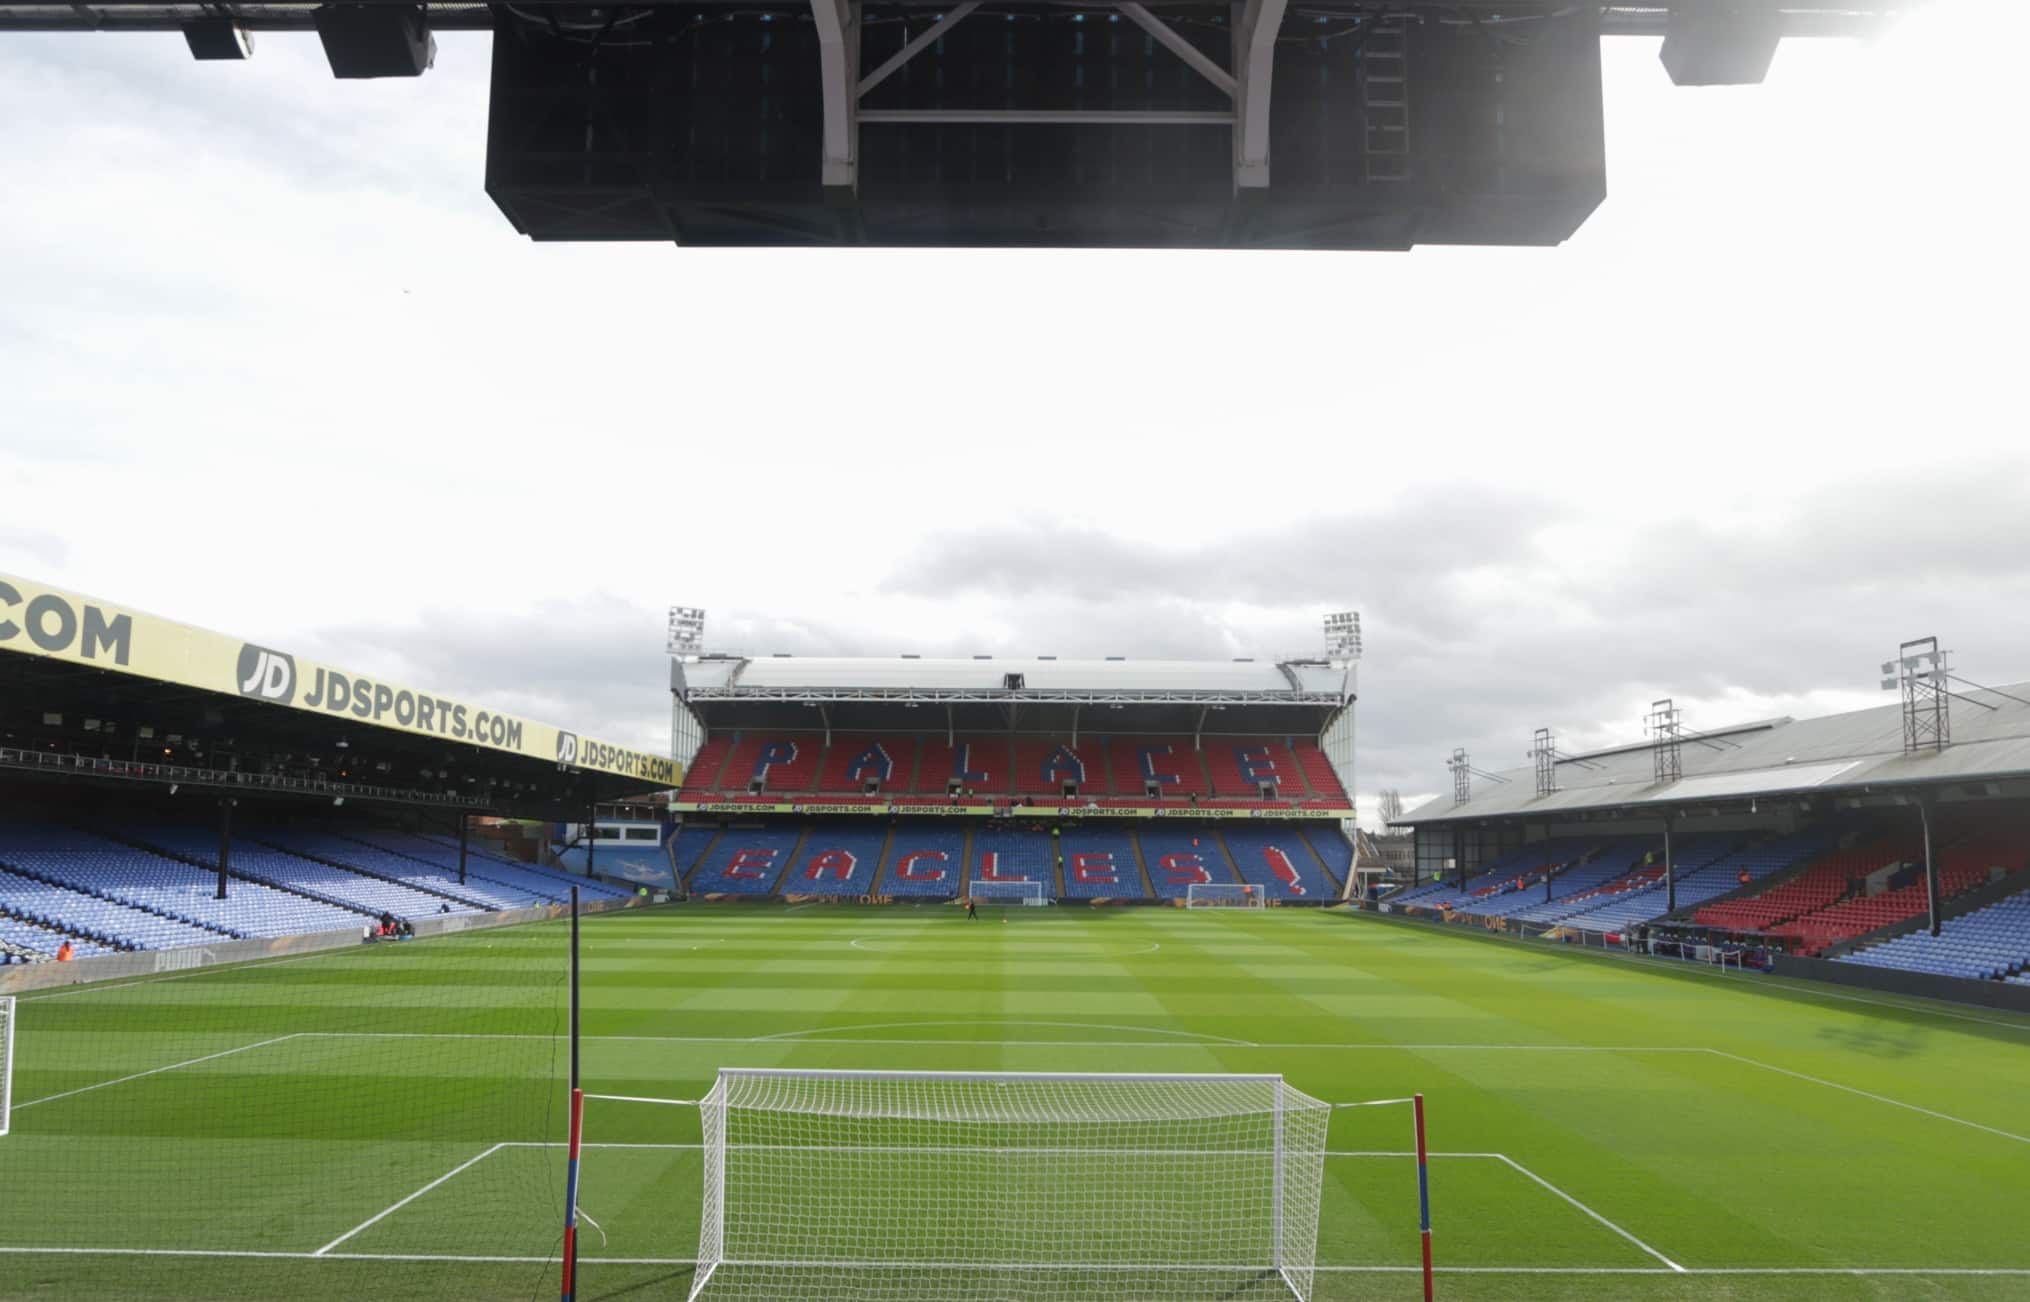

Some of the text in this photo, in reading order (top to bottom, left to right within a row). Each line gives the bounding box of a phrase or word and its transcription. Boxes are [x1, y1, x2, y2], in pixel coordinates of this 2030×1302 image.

[243, 651, 523, 750] JD JDSPORTS.COM
[580, 740, 673, 782] JDSPORTS.COM
[753, 741, 1281, 784] PALACE
